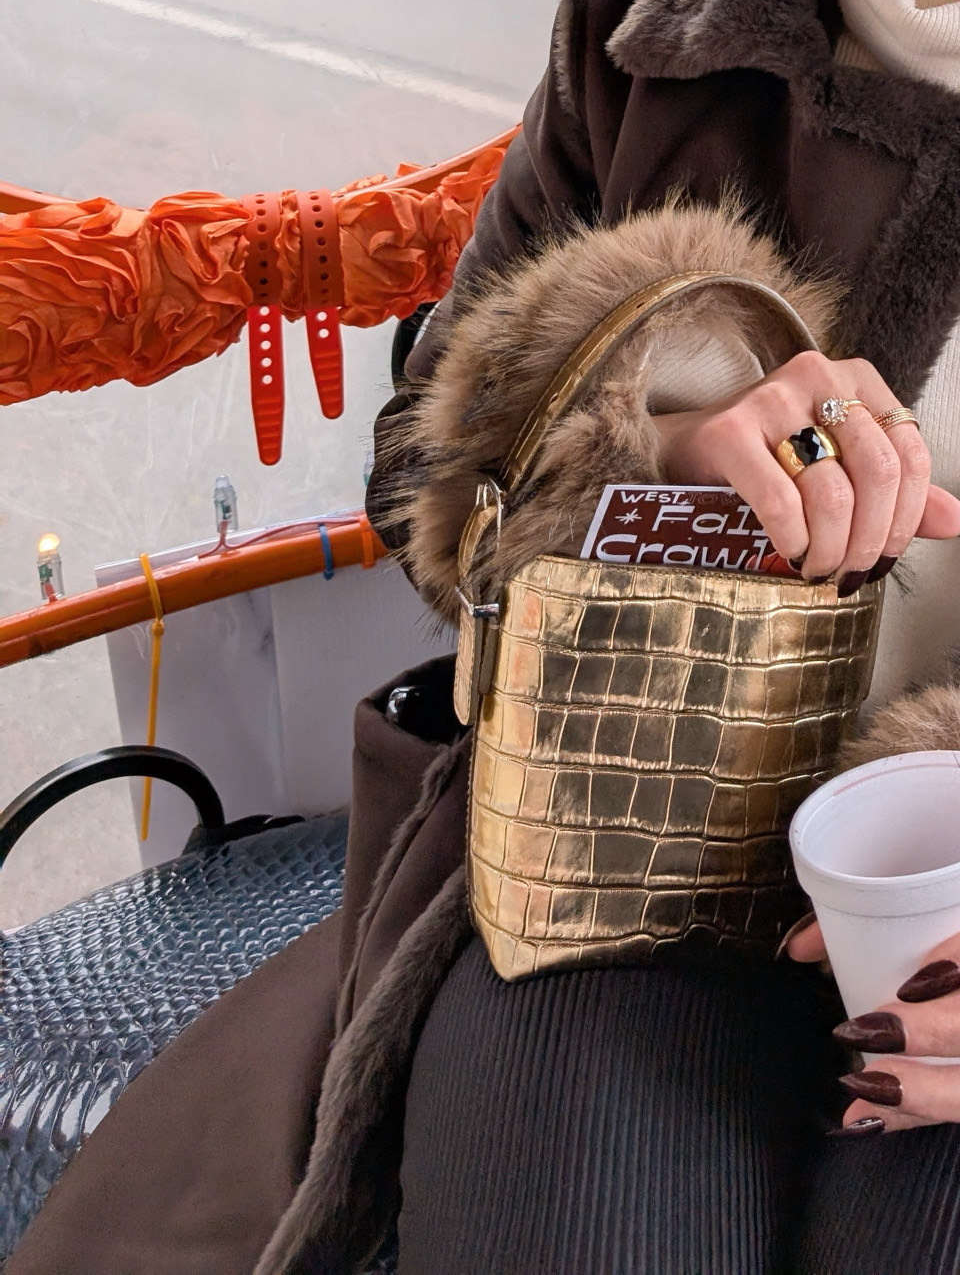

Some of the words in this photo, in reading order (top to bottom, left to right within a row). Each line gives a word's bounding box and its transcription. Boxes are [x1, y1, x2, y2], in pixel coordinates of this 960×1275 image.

[620, 491, 686, 504] WEST
[687, 492, 744, 505] TOW
[651, 505, 769, 537] Fal
[595, 533, 771, 571] Crawl
